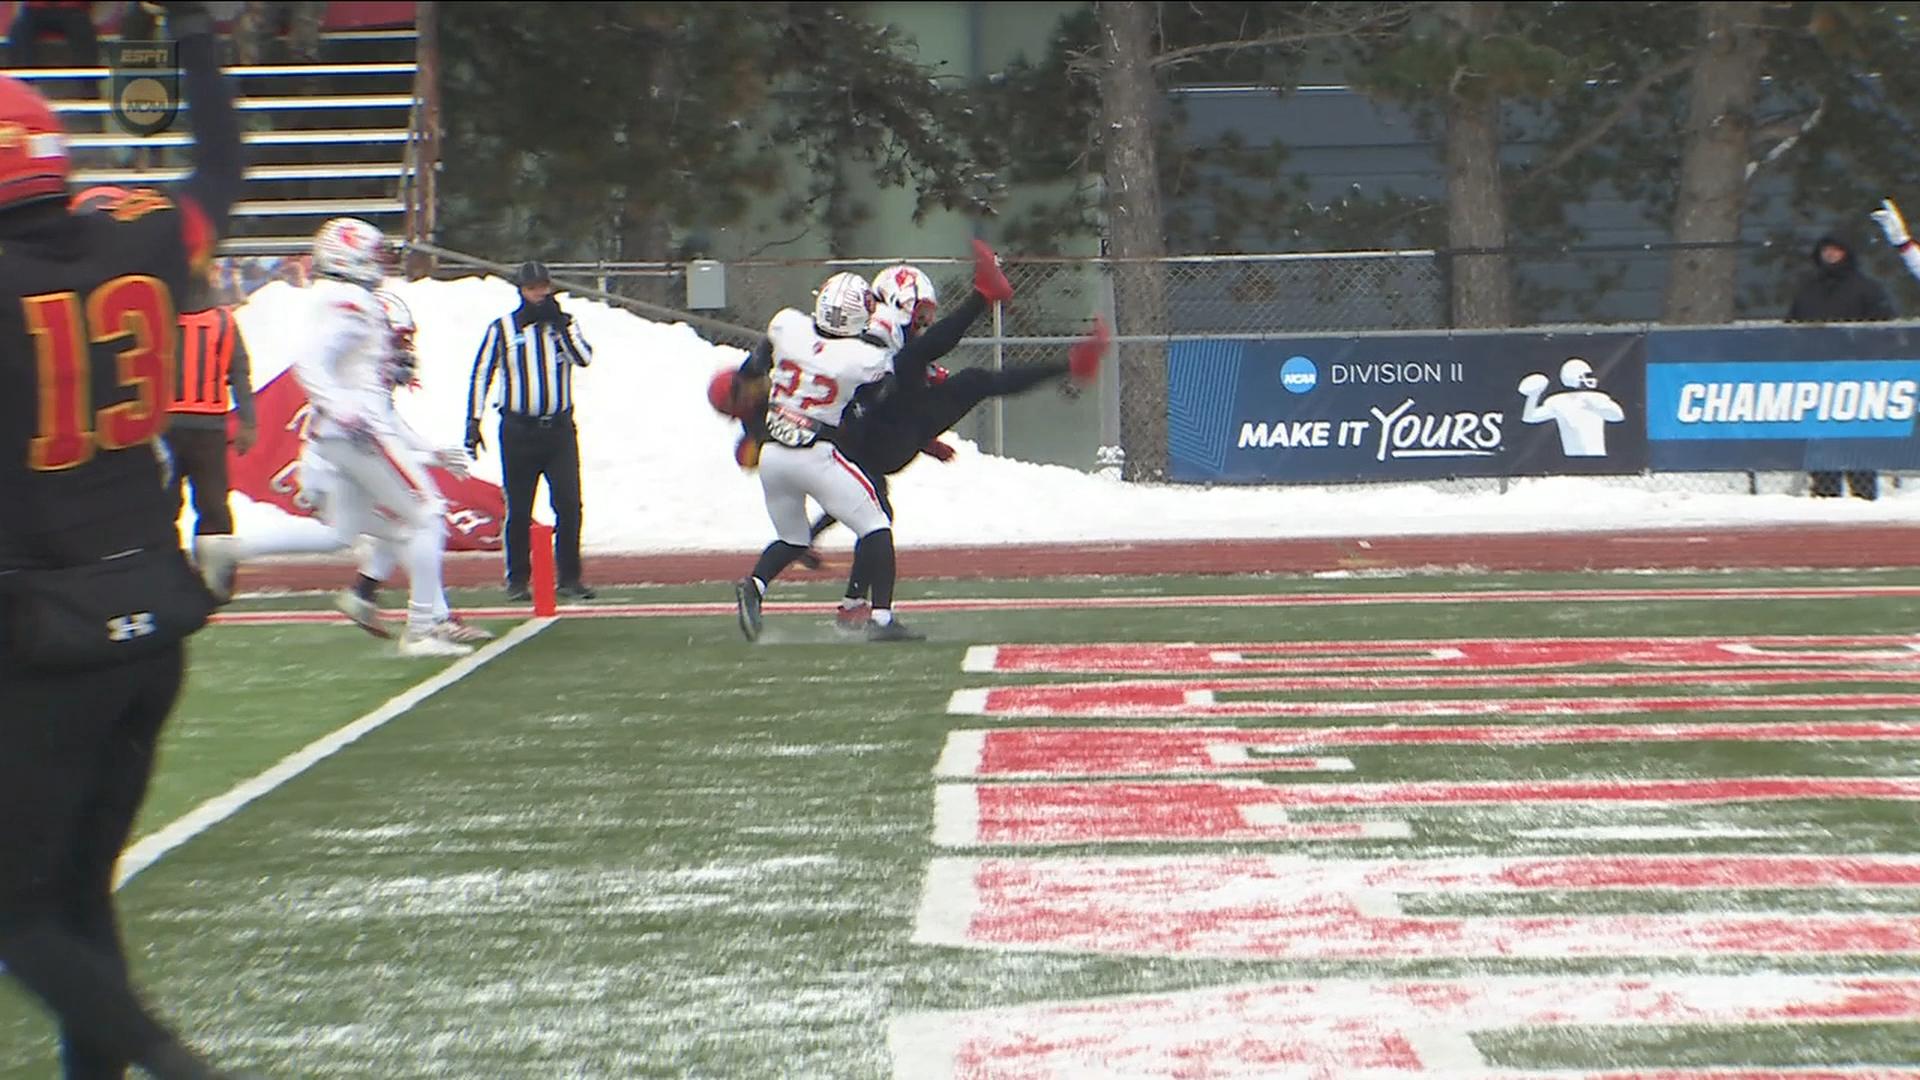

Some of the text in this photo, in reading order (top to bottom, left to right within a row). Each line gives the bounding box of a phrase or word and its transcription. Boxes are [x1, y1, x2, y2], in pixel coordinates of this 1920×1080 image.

[20, 272, 177, 471] 13
[772, 358, 839, 410] 22
[1283, 363, 1464, 385] NCAA DIVISION II
[1237, 398, 1504, 462] MAKE IT YOURS
